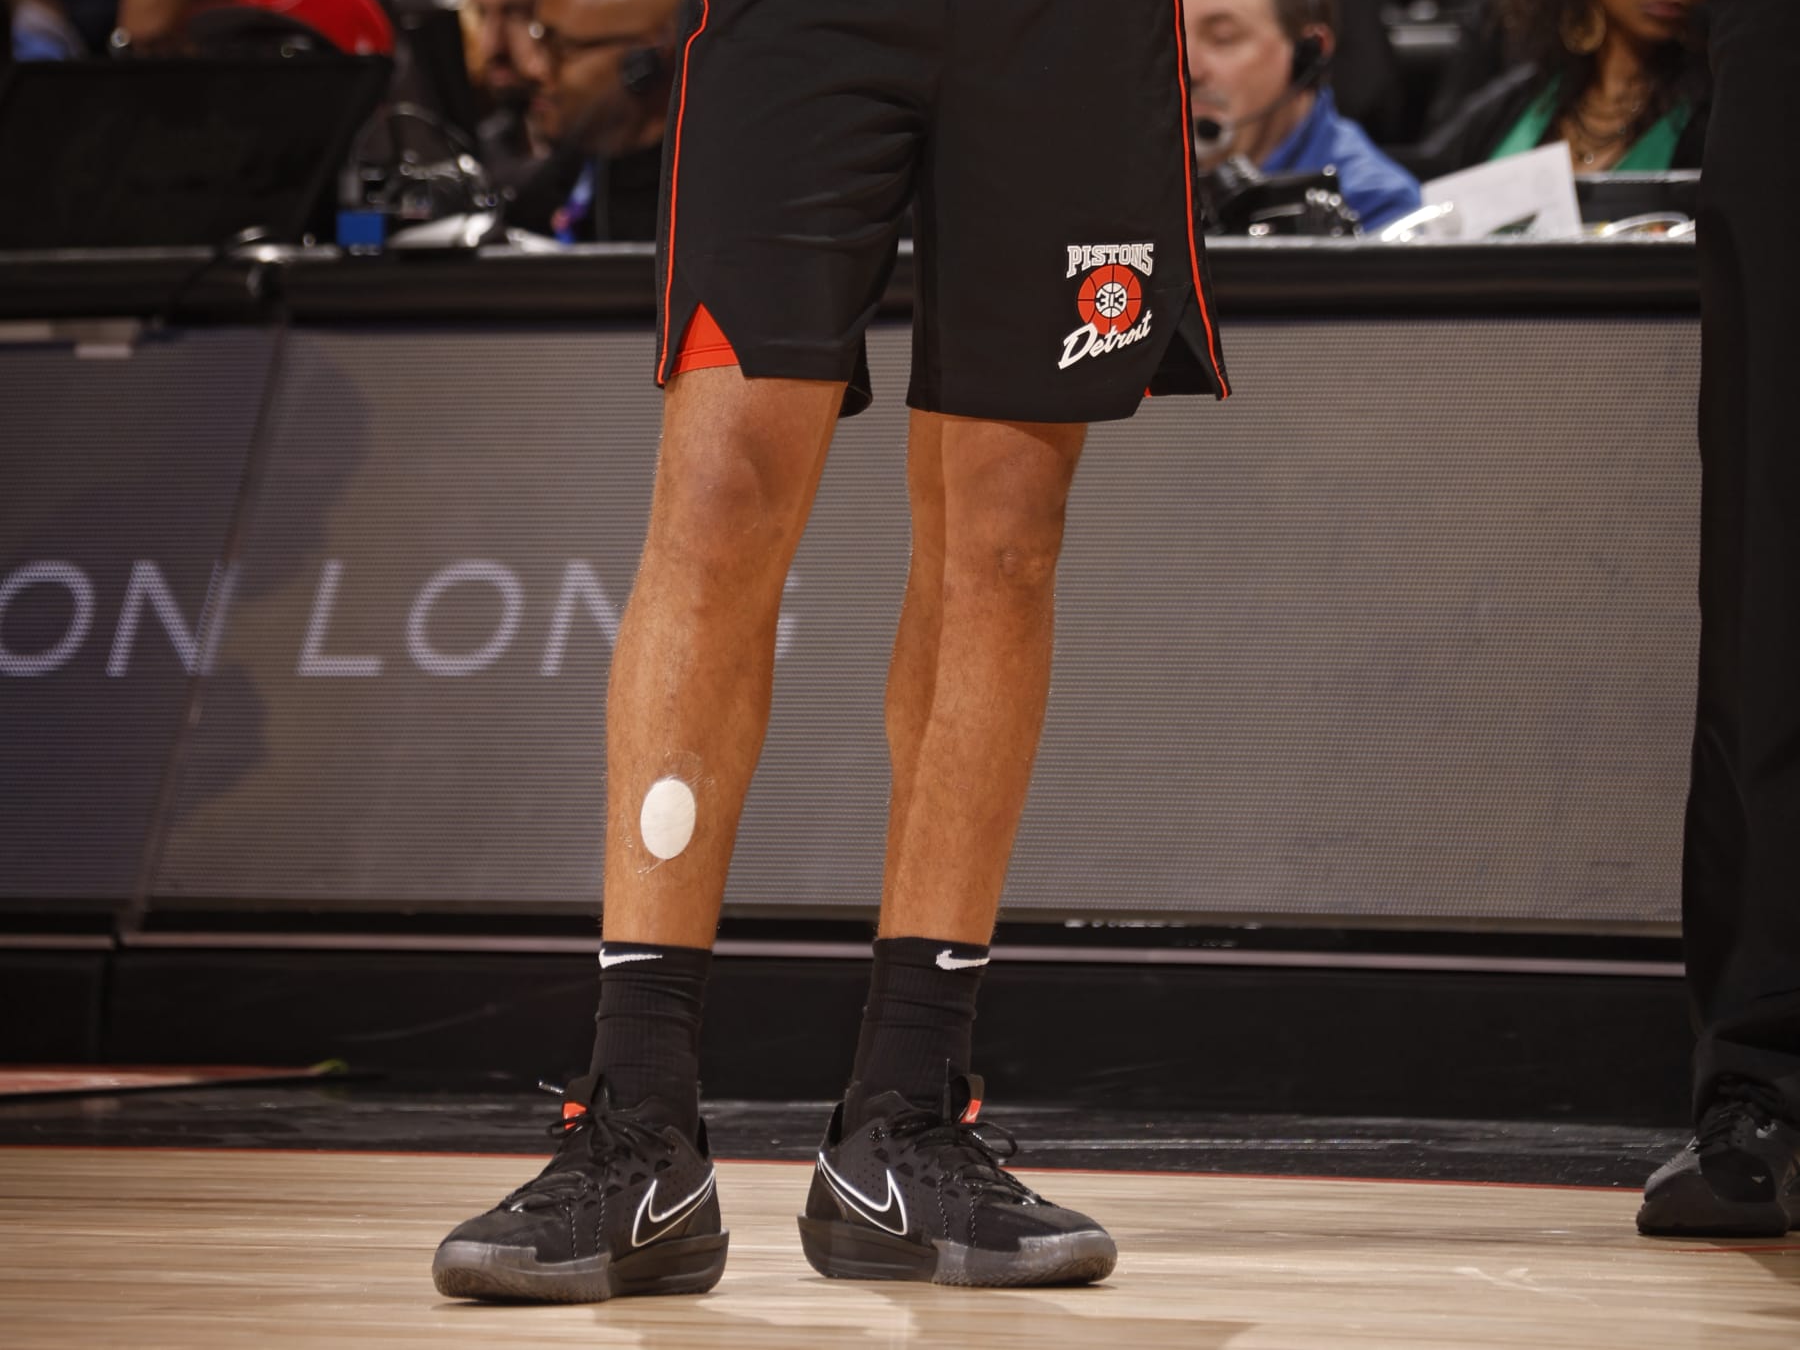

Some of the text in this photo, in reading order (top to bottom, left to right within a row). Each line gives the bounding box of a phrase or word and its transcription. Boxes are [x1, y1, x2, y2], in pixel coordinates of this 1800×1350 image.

[1066, 243, 1154, 279] PISTONS
[1058, 310, 1152, 370] Detroit
[296, 559, 800, 677] LON
